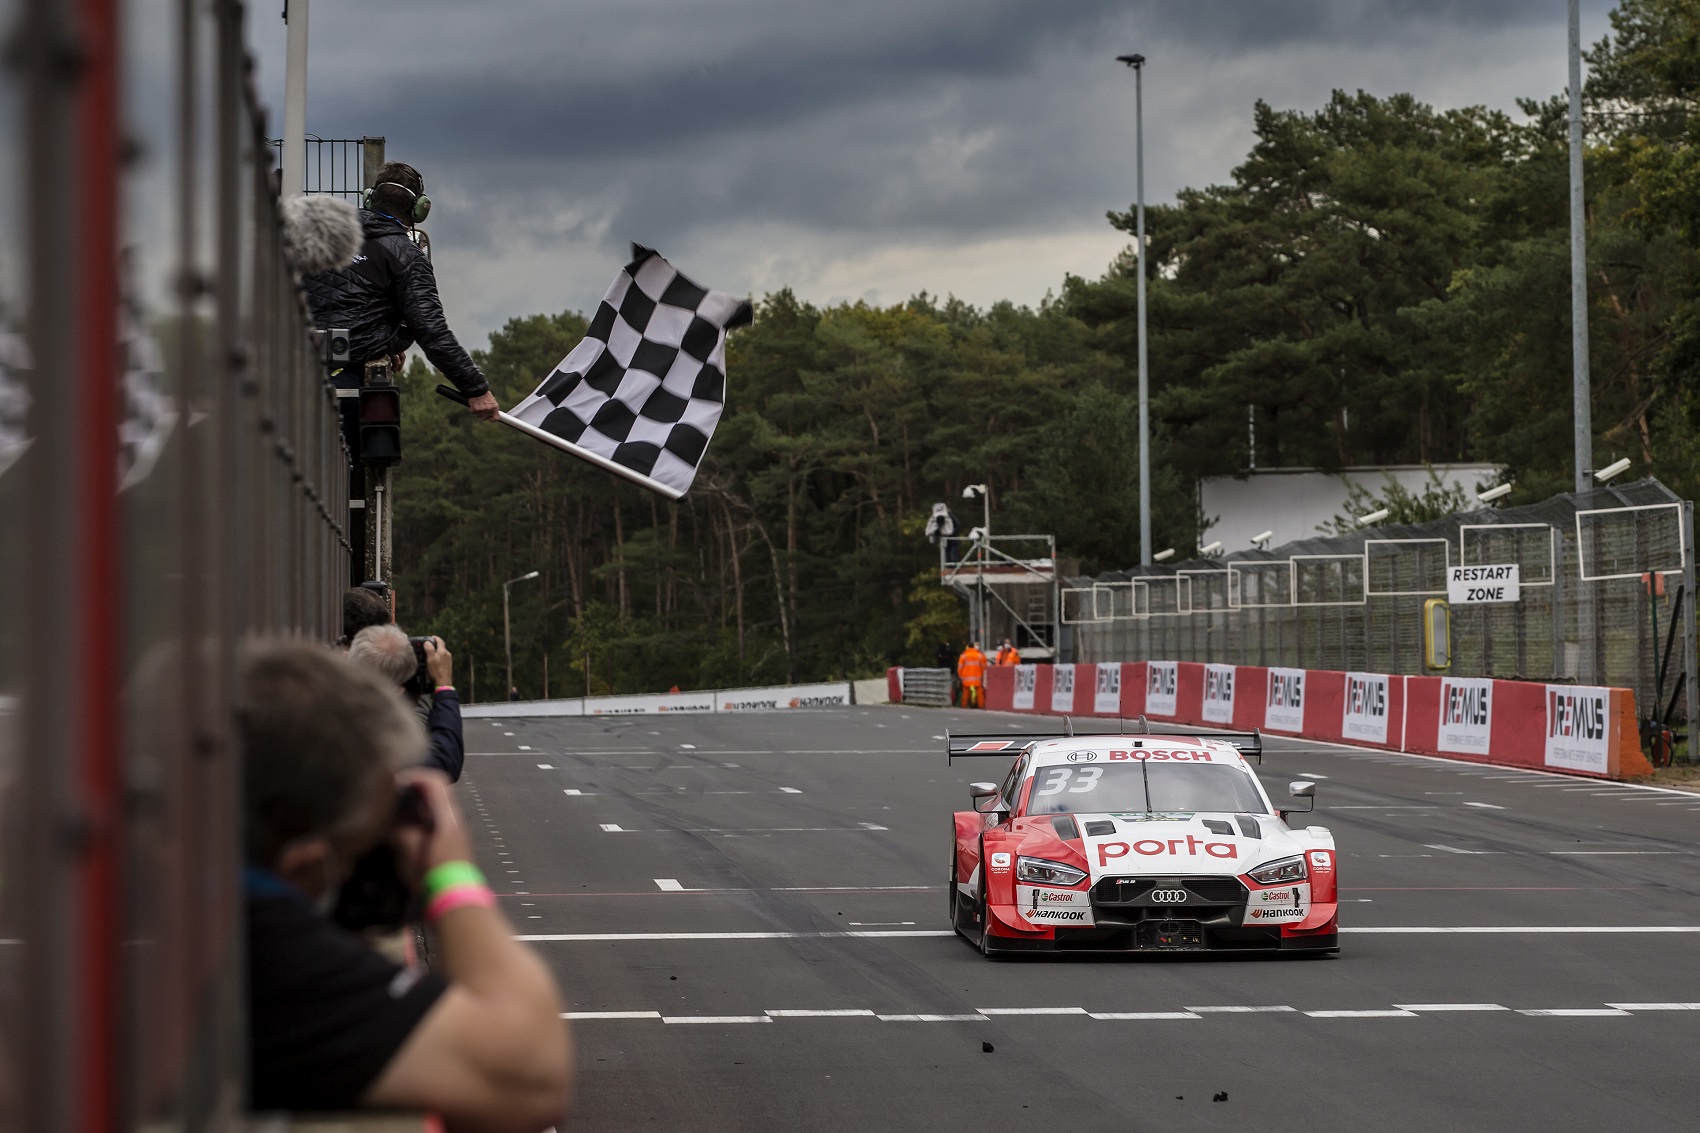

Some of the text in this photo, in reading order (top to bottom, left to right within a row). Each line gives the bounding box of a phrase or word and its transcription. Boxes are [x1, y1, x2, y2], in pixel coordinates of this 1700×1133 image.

[1453, 567, 1513, 581] RESTART
[1467, 587, 1504, 601] ZONE
[1273, 675, 1301, 708] REMUS
[1350, 680, 1385, 718] REMUS
[1448, 687, 1487, 727] REMUS
[1555, 695, 1604, 741] REMUS
[1109, 750, 1213, 762] BOSCH
[1037, 766, 1104, 796] 33
[1097, 834, 1239, 867] porta
[1048, 892, 1073, 902] Castrol
[1268, 891, 1290, 901] Castrol
[1034, 910, 1085, 920] HANKOOK
[1262, 908, 1304, 918] HANKOOK
